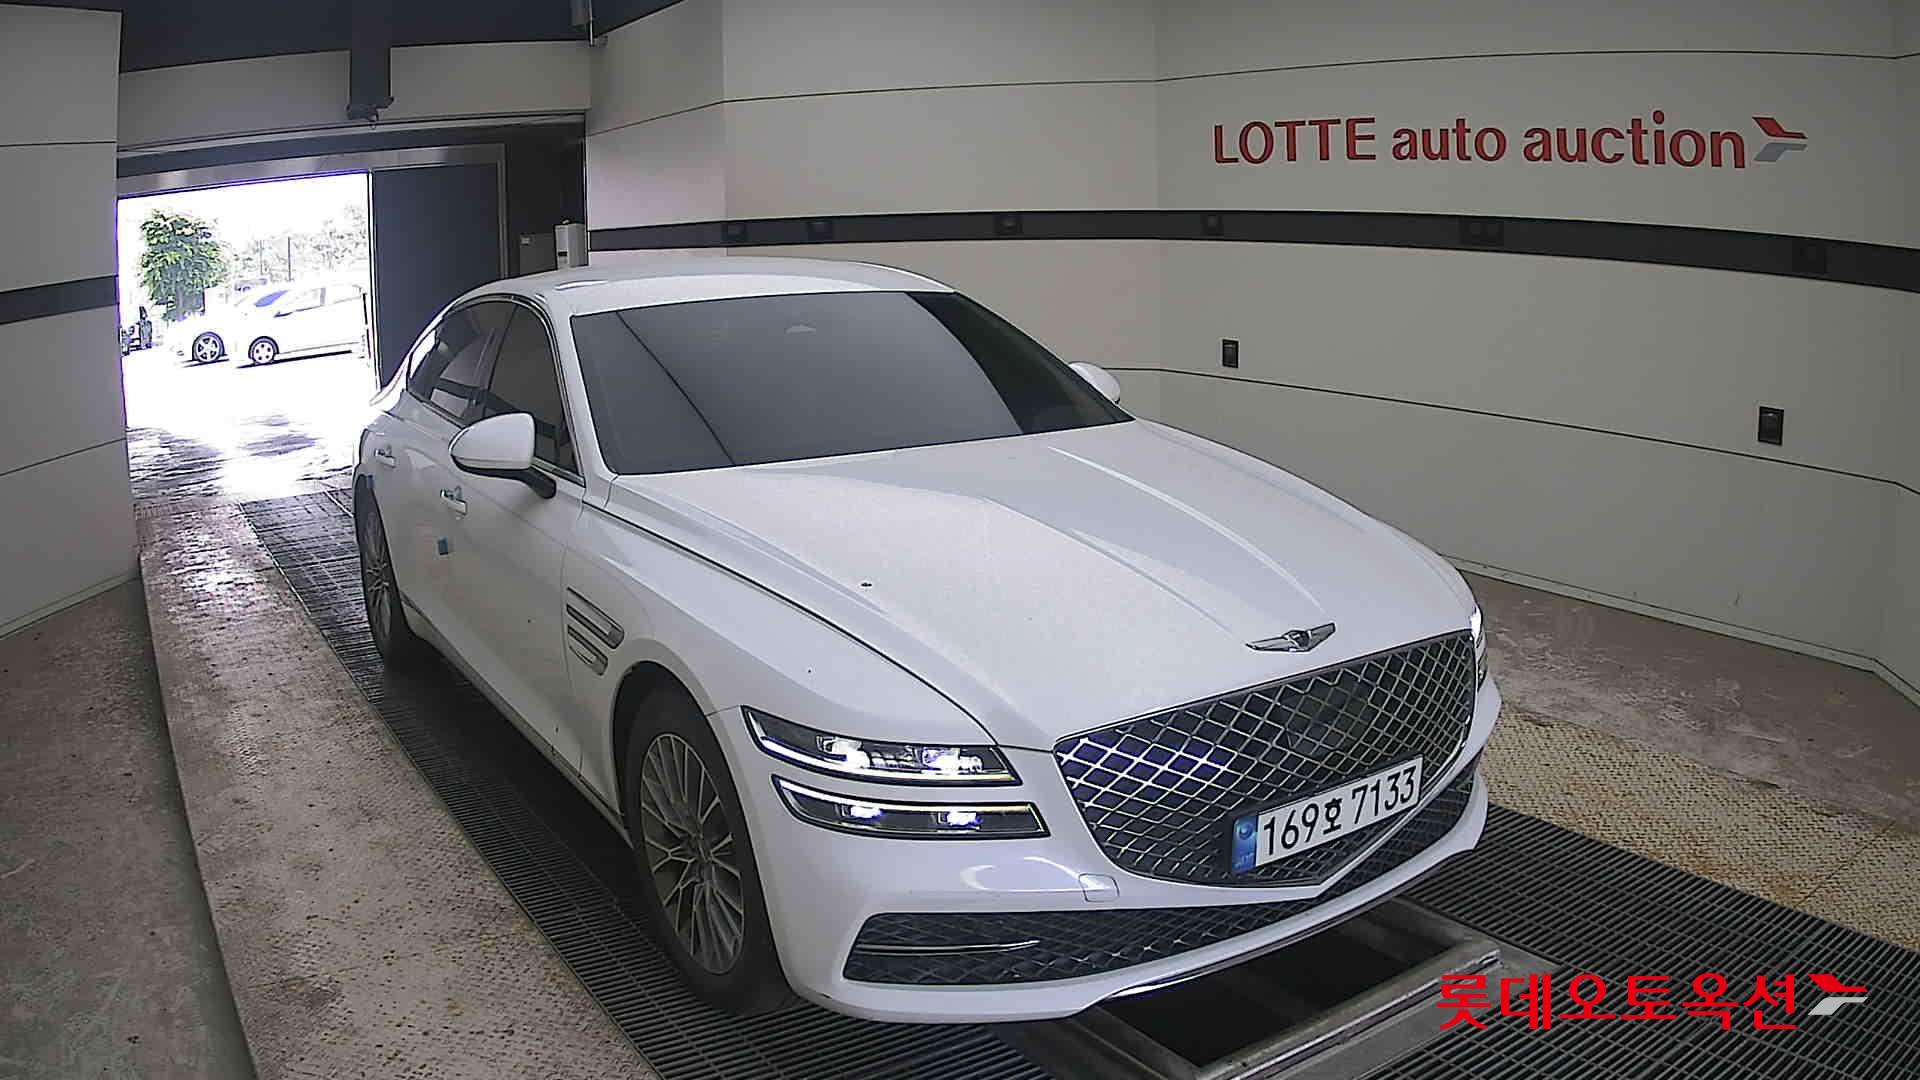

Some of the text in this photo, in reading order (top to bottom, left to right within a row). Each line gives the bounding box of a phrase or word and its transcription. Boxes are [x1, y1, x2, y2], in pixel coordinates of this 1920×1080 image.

[1214, 110, 1745, 168] LOTTE auto auction
[1263, 766, 1417, 856] 169호 7133
